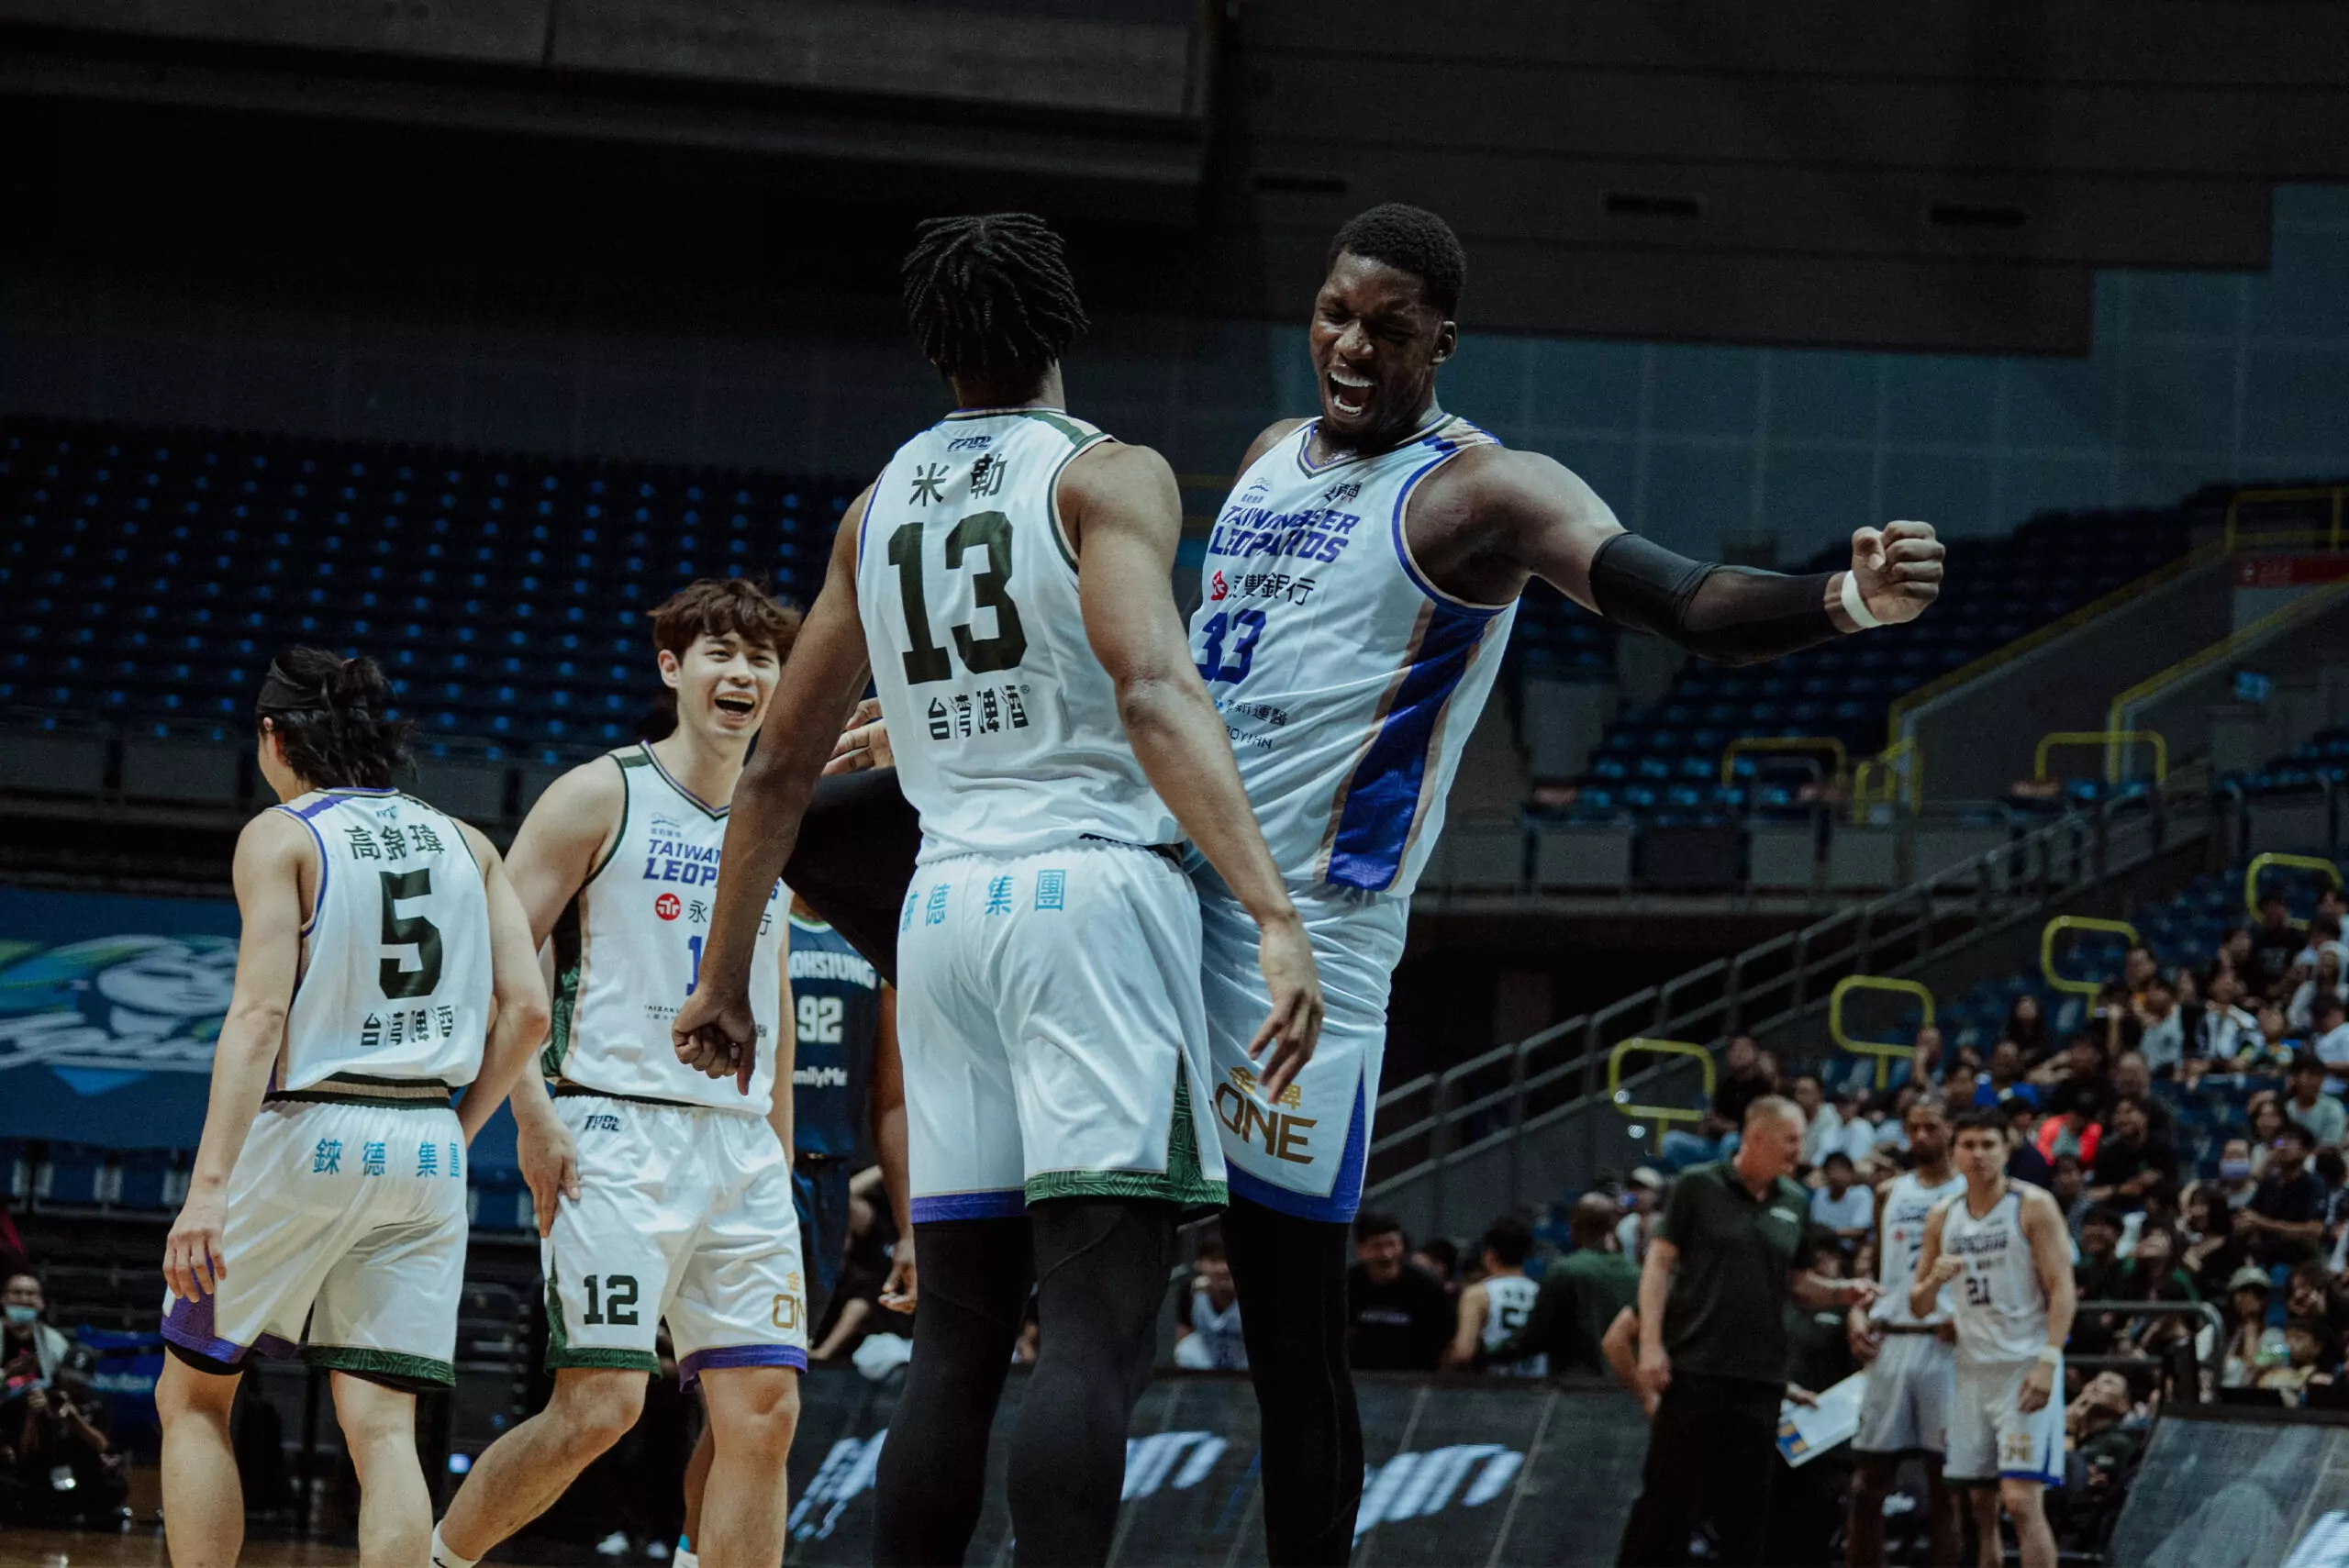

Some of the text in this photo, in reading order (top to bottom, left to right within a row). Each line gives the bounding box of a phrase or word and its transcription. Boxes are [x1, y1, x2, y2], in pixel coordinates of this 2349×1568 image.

[908, 453, 1008, 506] 米勒
[888, 510, 1028, 685] 13
[379, 868, 442, 1000] 5
[797, 995, 843, 1044] 92
[1215, 1083, 1318, 1164] ONE
[584, 1274, 639, 1325] 12
